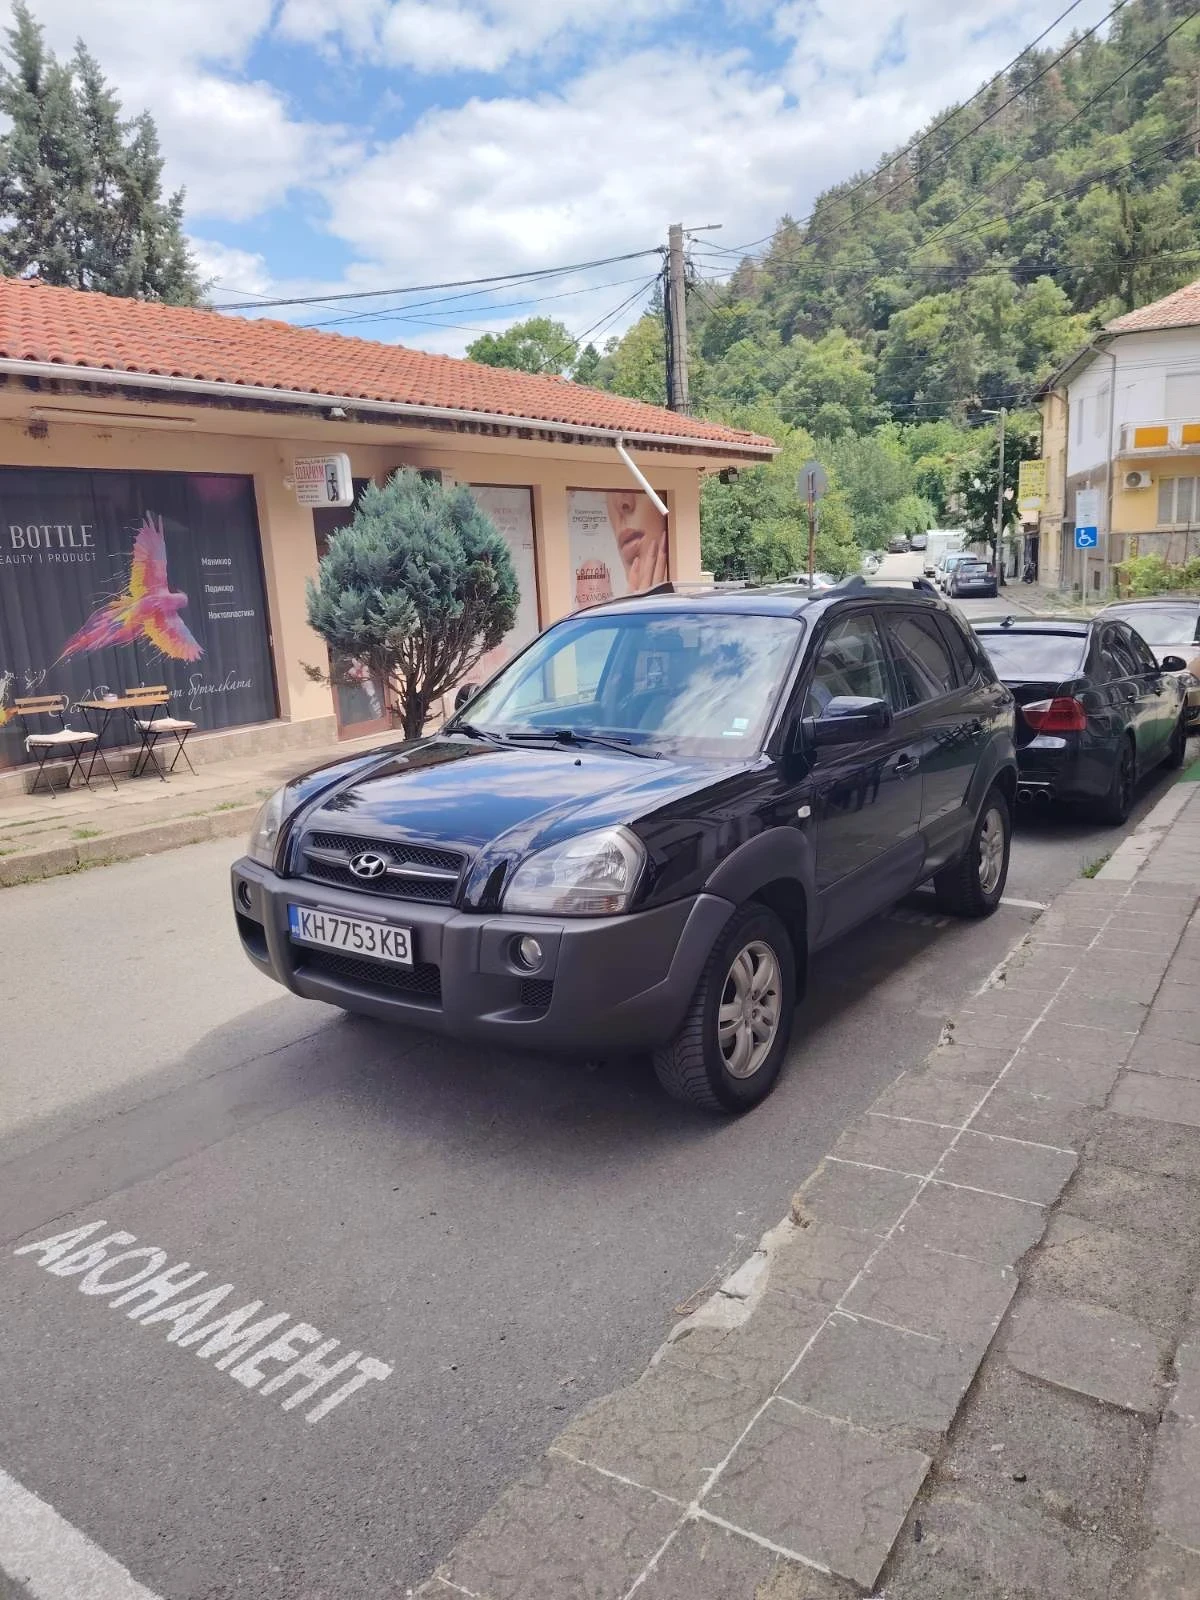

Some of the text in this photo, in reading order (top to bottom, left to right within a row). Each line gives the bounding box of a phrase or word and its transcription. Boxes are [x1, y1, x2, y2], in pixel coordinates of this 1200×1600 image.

[8, 525, 95, 548] BOTTLE
[48, 552, 96, 563] PRODUCT
[201, 557, 232, 567] Маникюр
[204, 584, 234, 593] Педикюр
[301, 911, 408, 959] KH7753KB
[13, 1220, 393, 1423] АБОНАМЕНТ
